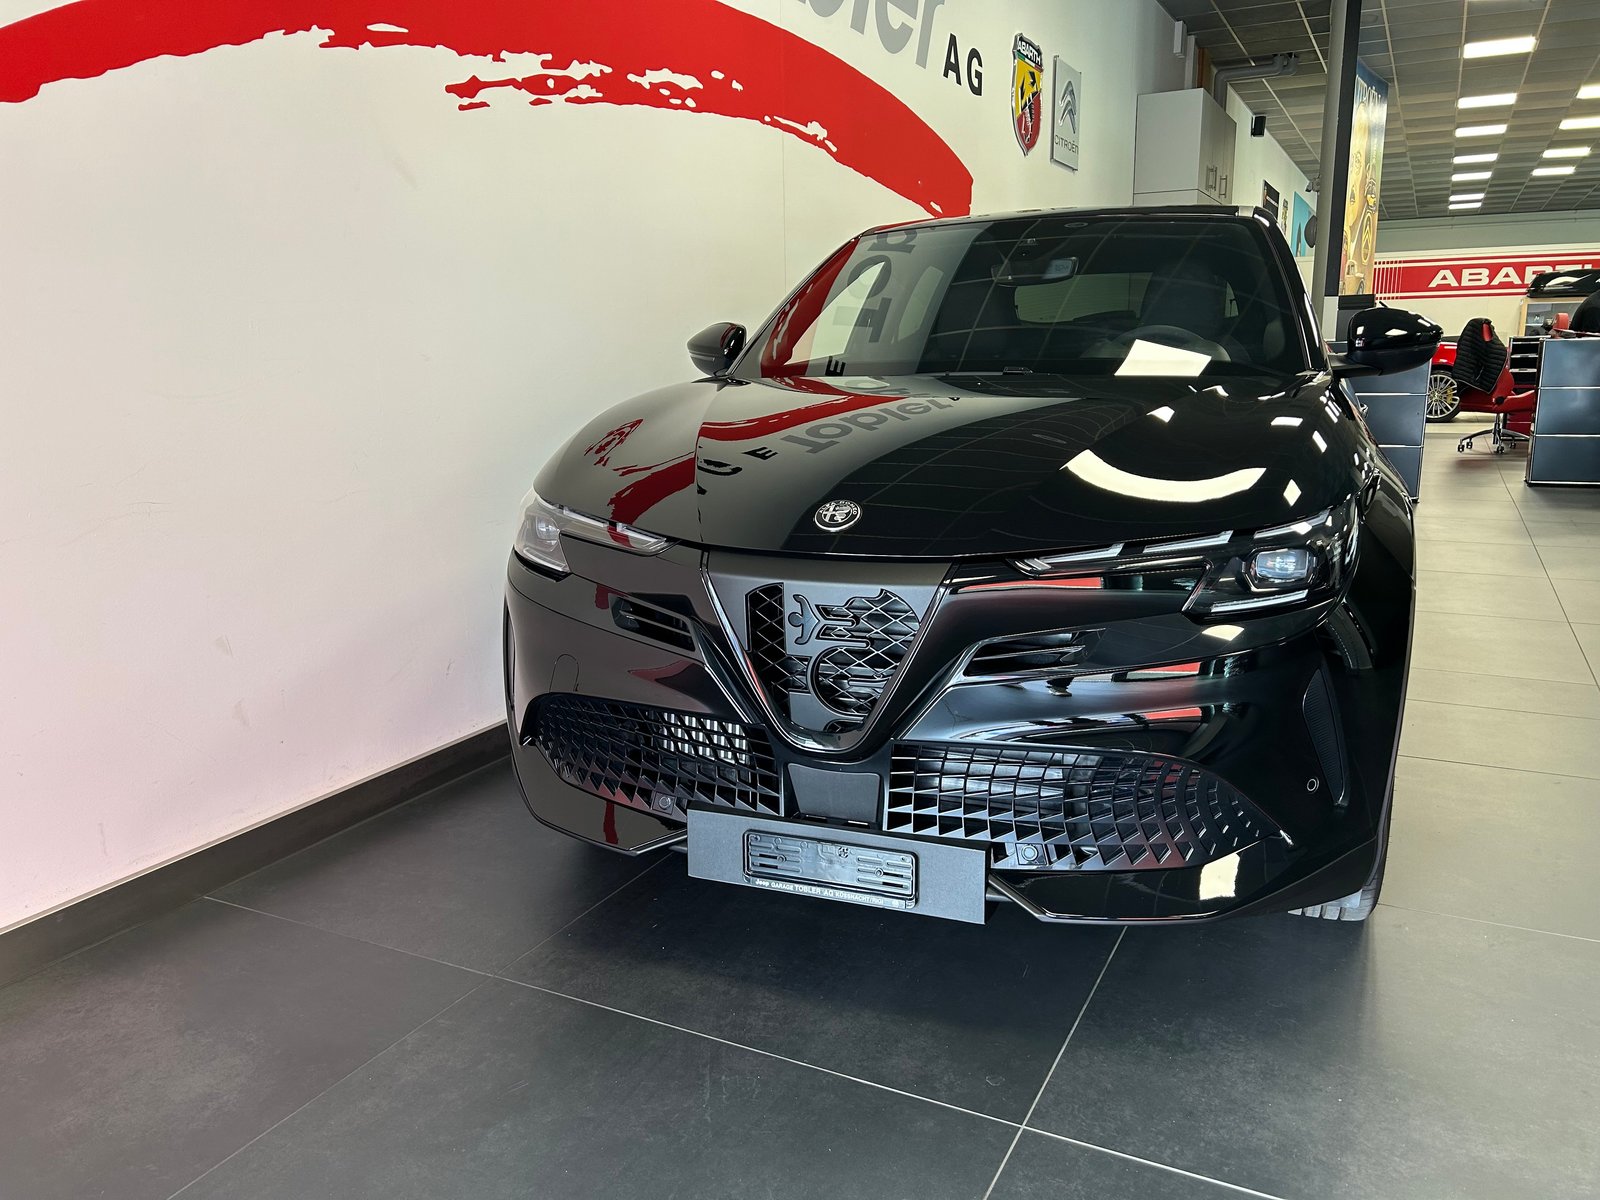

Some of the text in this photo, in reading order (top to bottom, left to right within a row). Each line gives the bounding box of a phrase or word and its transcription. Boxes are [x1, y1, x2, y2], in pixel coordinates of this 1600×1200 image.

[943, 33, 983, 96] AG
[1016, 40, 1041, 66] ABARTH
[1428, 264, 1592, 287] ABAR
[794, 884, 822, 896] TOBLER
